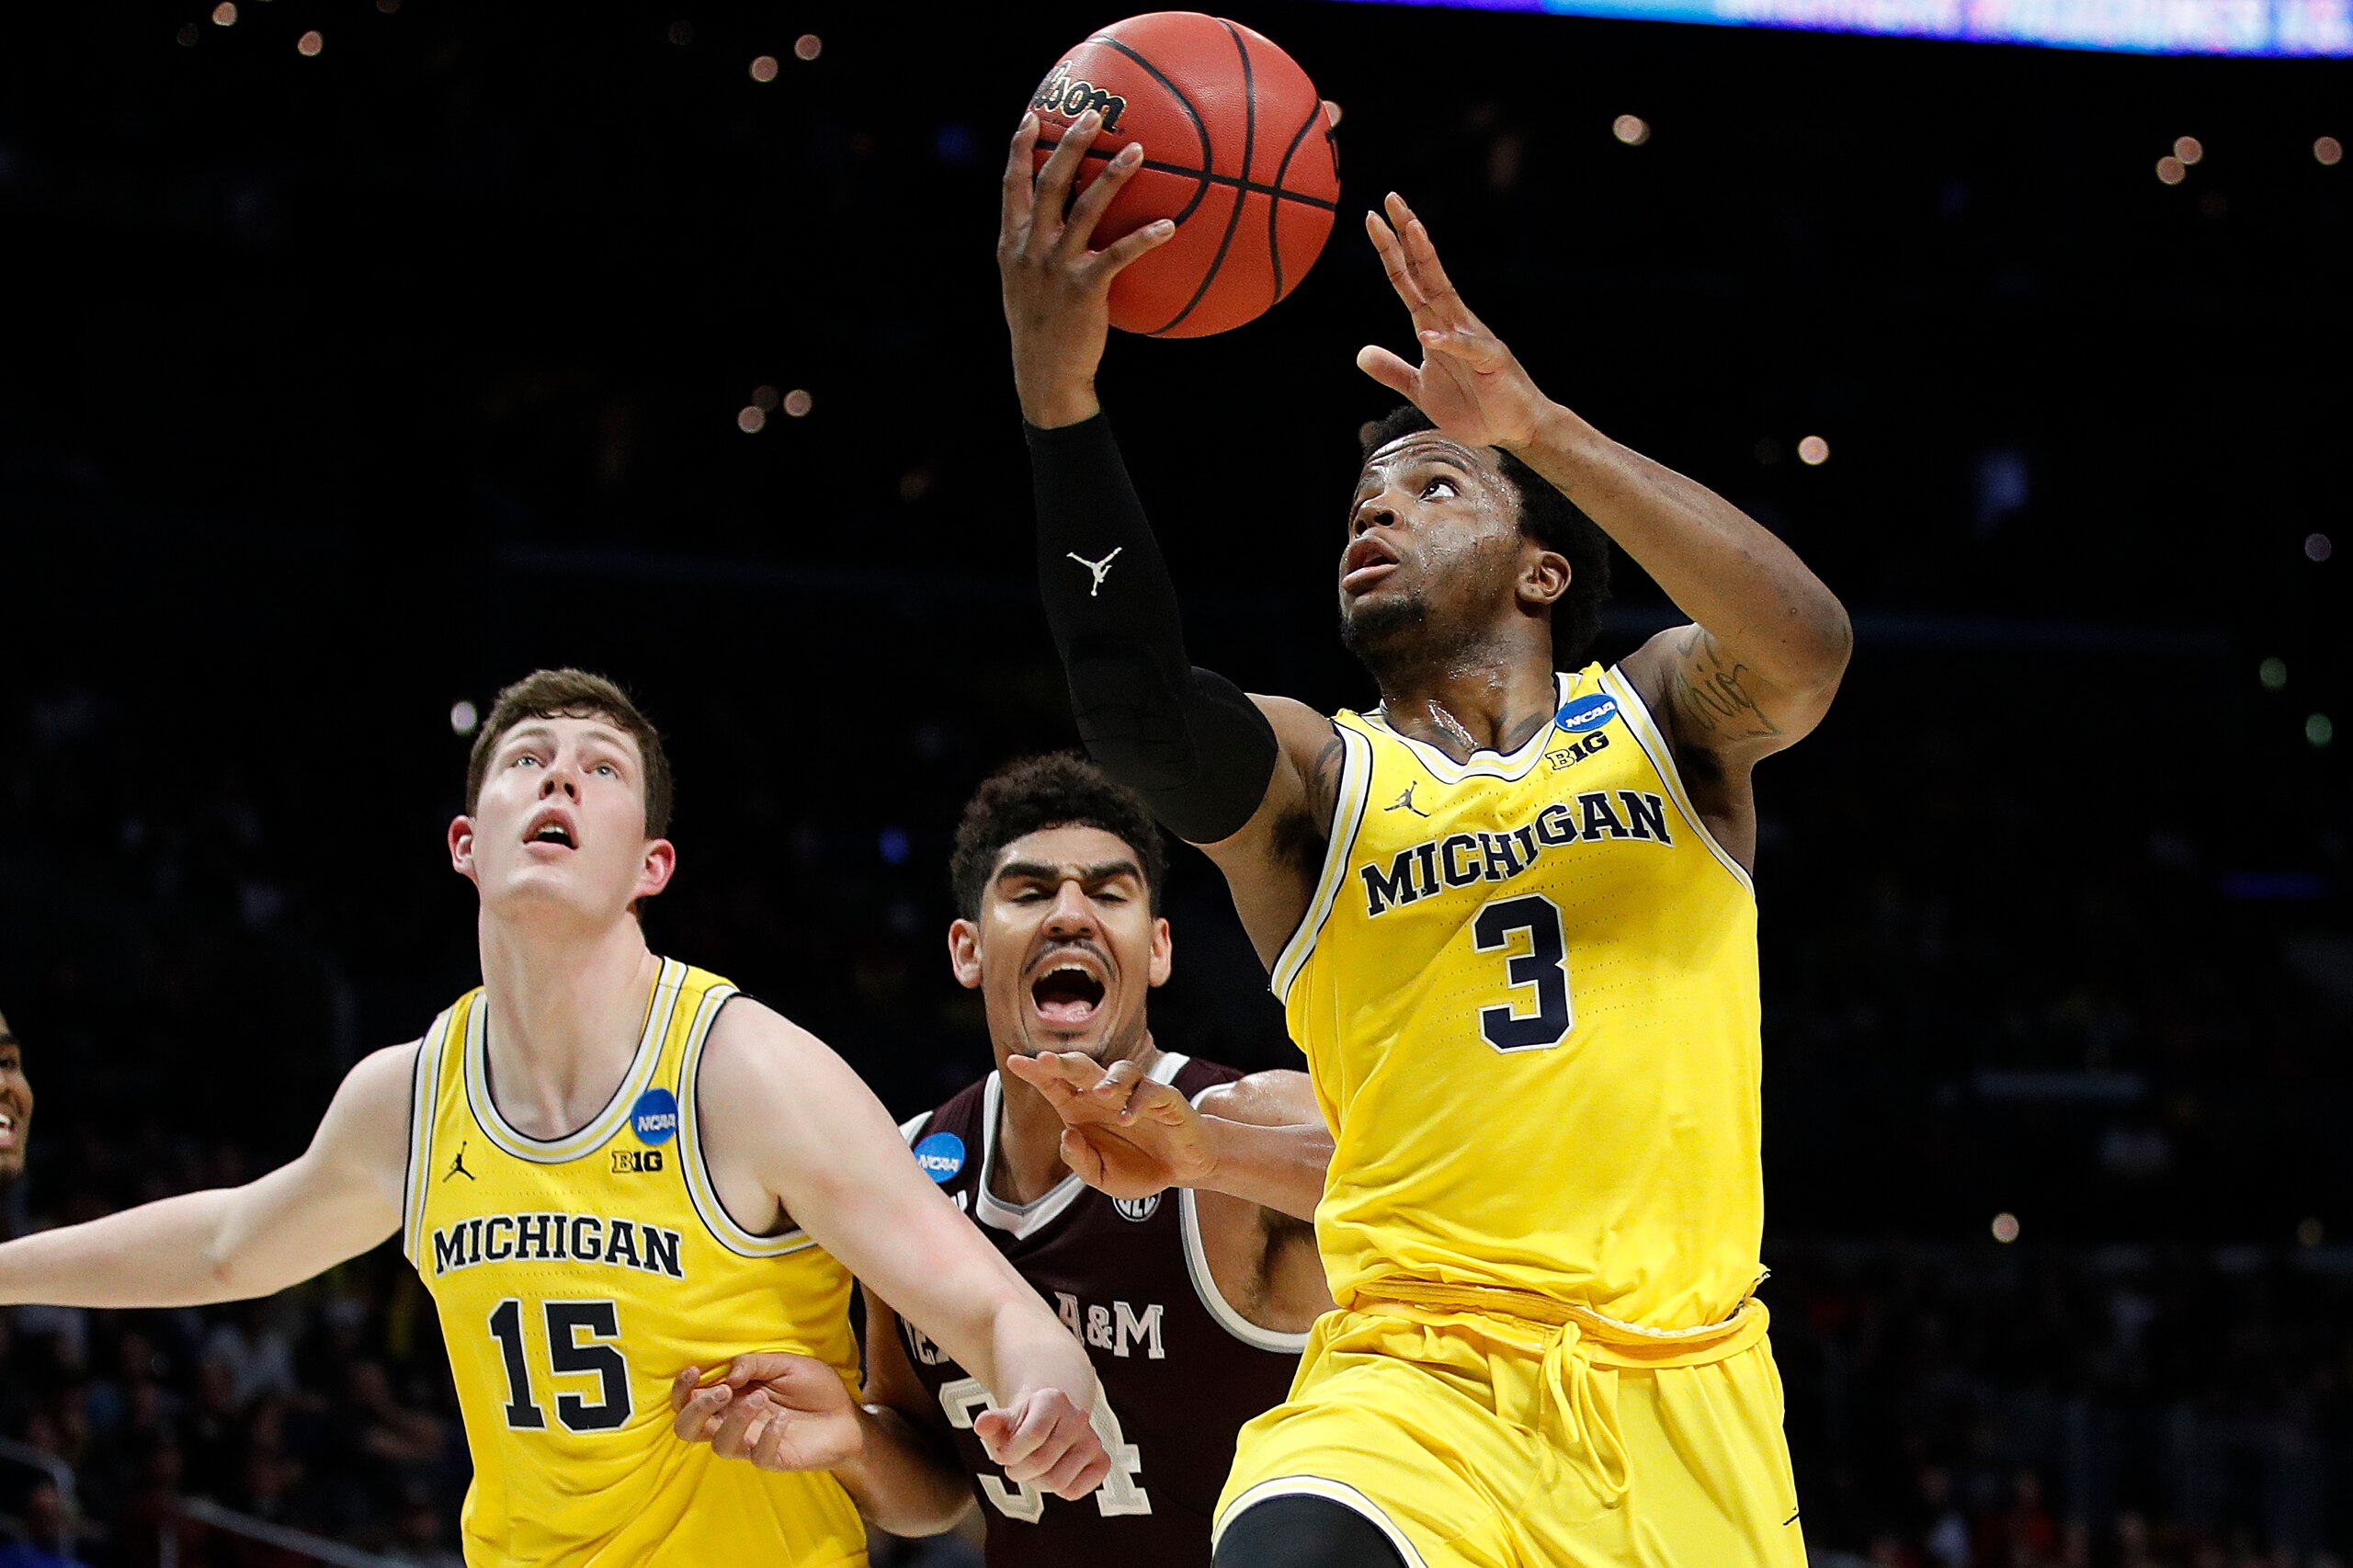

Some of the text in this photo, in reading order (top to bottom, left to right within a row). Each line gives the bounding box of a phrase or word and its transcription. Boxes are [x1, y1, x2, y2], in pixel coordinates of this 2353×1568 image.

[1031, 60, 1127, 134] lson
[1565, 701, 1616, 728] NCAA
[1358, 790, 1674, 919] MICHIGAN
[1471, 892, 1574, 1055] 3
[638, 1113, 676, 1132] NCAA
[919, 1154, 960, 1173] NCAA
[432, 1211, 687, 1280] MICHIGAN
[487, 1296, 634, 1435] 15
